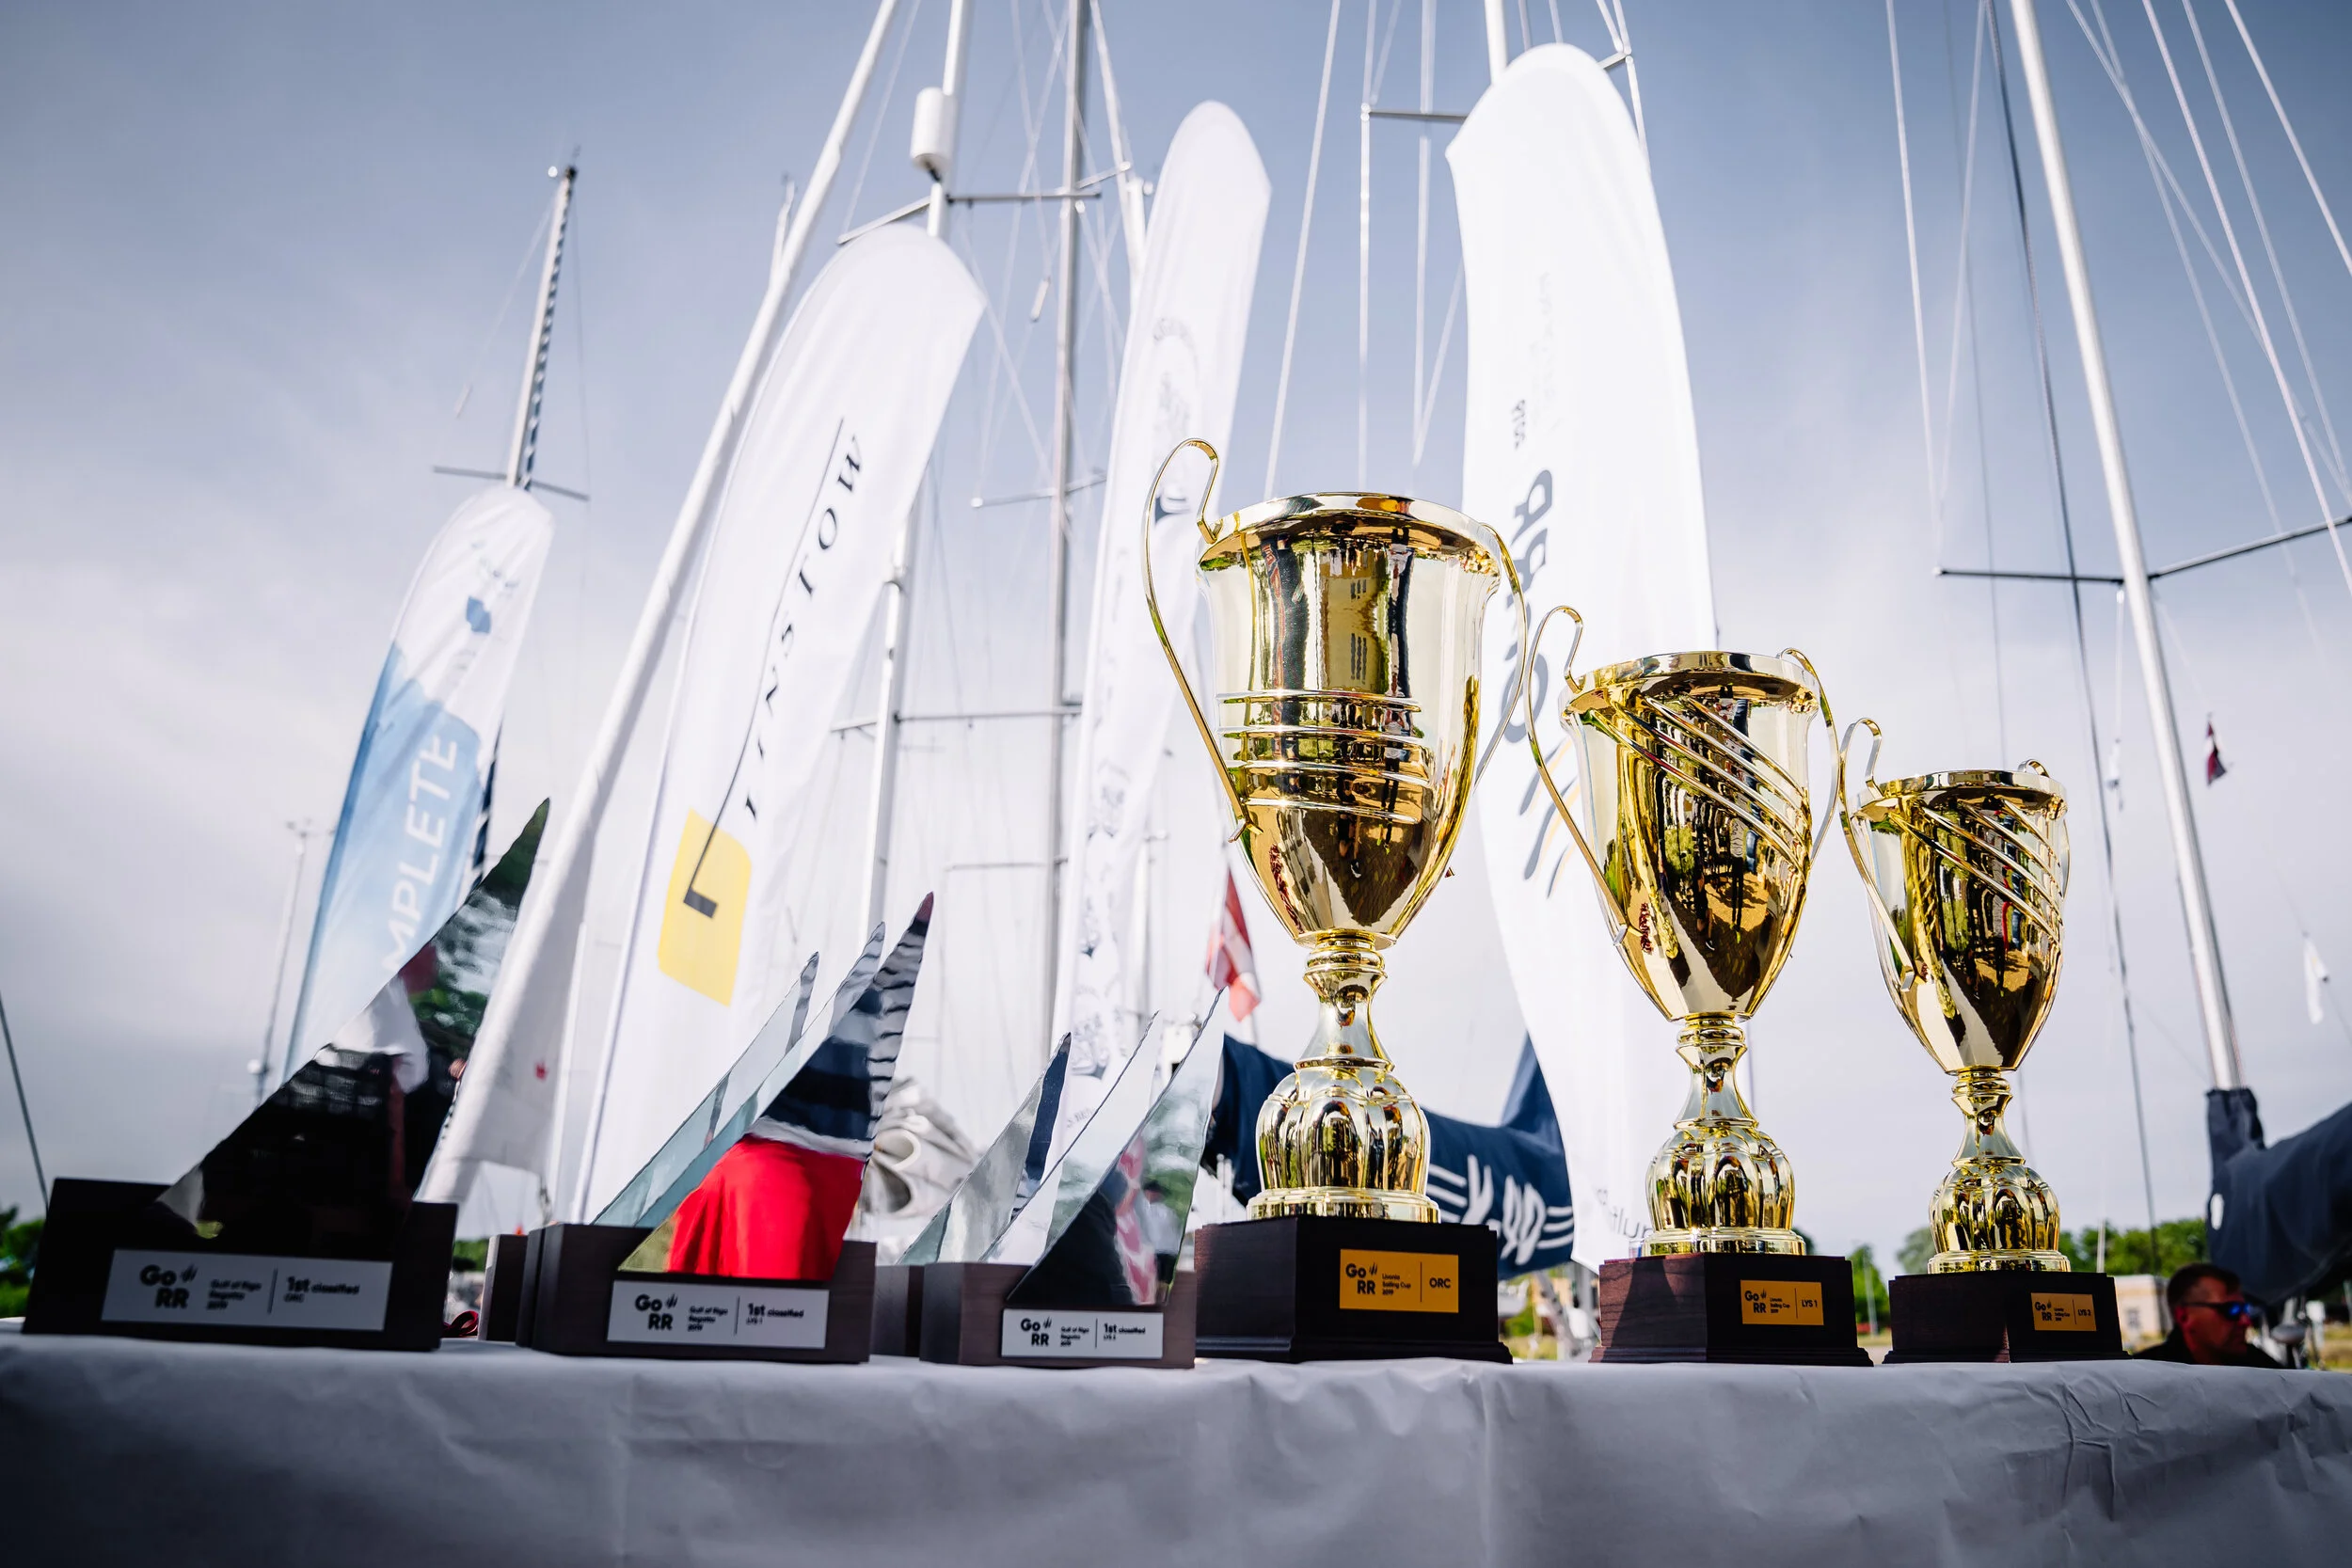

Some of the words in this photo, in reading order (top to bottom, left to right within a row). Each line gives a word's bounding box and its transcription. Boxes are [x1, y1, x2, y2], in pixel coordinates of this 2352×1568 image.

[1345, 1263, 1367, 1278] Go
[288, 1276, 310, 1292] 1st
[1357, 1280, 1375, 1294] RR
[1429, 1277, 1451, 1289] ORC
[154, 1288, 189, 1308] RR
[635, 1294, 662, 1311] Go
[1744, 1291, 1759, 1301] Go
[1802, 1299, 1813, 1307] LYS
[748, 1303, 765, 1316] 1st
[767, 1308, 804, 1319] classified
[1753, 1303, 1767, 1313] RR
[648, 1313, 673, 1331] RR
[1020, 1318, 1041, 1332] Go
[1104, 1323, 1117, 1333] 1st
[1031, 1333, 1049, 1346] RR
